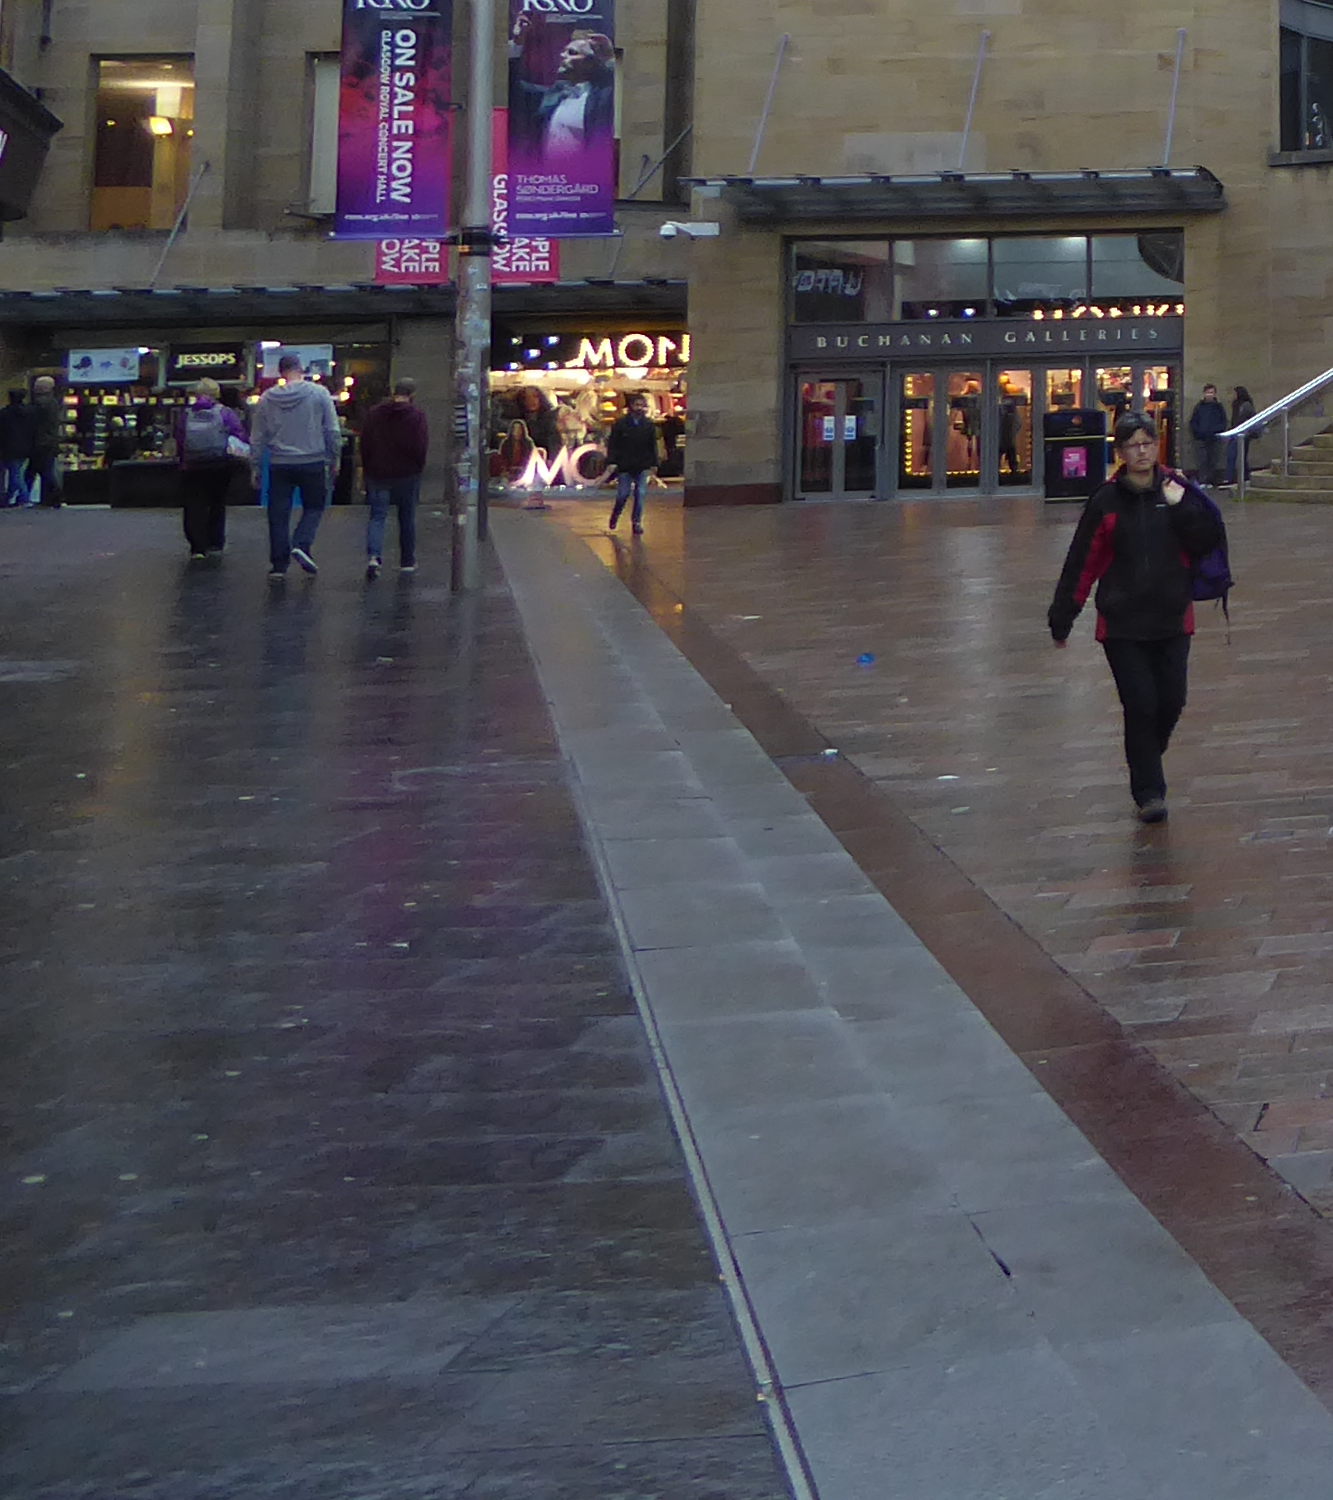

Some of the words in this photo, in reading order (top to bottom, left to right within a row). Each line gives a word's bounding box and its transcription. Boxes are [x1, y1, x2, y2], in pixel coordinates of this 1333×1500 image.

[379, 30, 392, 85] GLASGOW
[394, 29, 417, 66] ON
[378, 85, 390, 120] ROYAL
[392, 72, 415, 135] SALE
[377, 121, 389, 173] CONCERT
[376, 174, 387, 204] HALL
[390, 141, 413, 204] NOW
[516, 174, 566, 184] THOMAS
[401, 239, 420, 273] AKE
[511, 237, 530, 272] AKE
[816, 332, 976, 349] BUCHANAN
[1004, 327, 1160, 344] GALLERIES
[174, 352, 236, 369] JESSOPS
